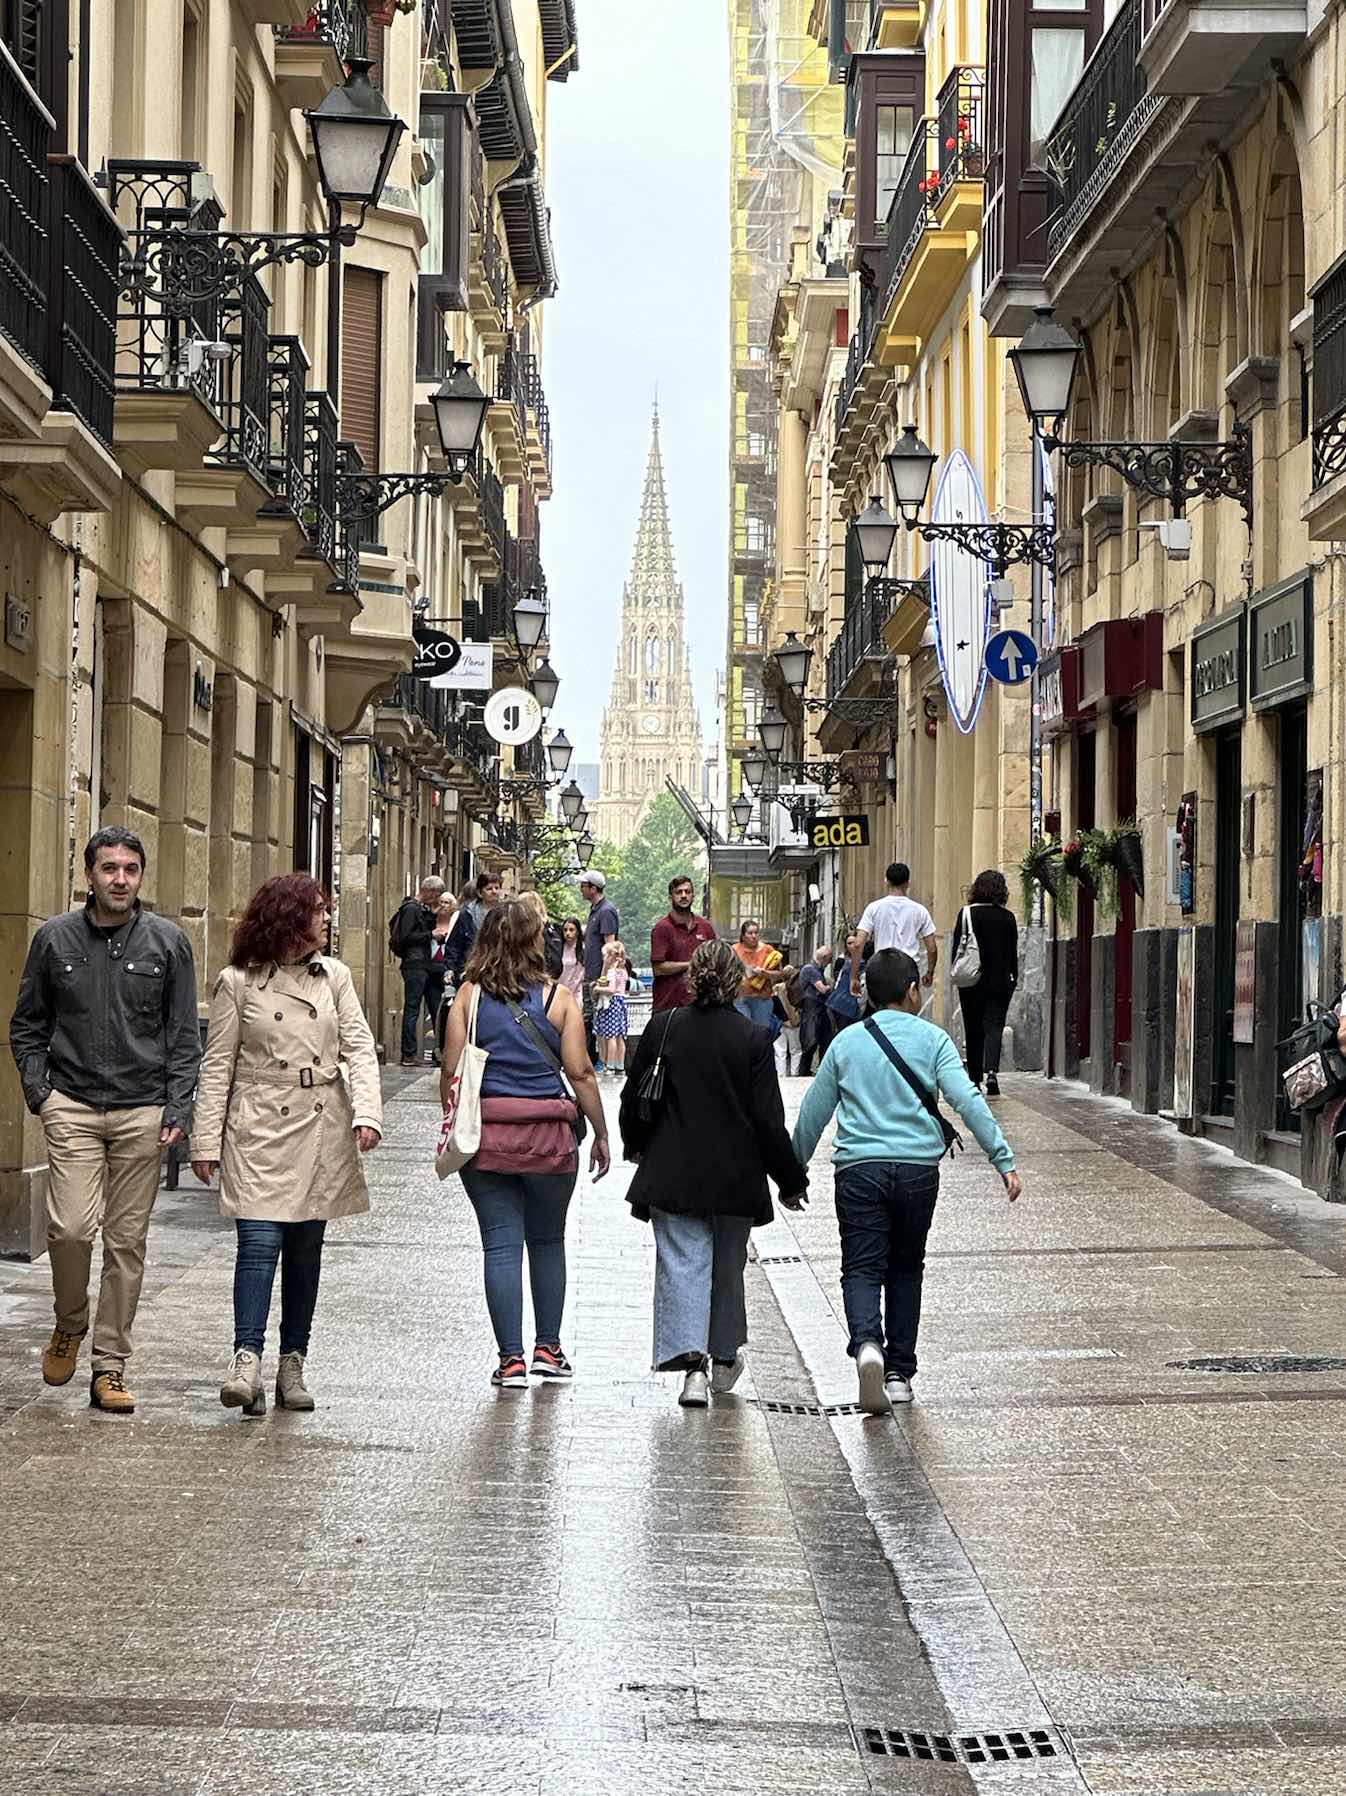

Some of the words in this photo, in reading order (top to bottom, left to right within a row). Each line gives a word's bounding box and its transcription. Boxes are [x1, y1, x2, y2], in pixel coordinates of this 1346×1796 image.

[414, 641, 454, 659] KO
[503, 706, 520, 731] g
[813, 817, 862, 847] ada
